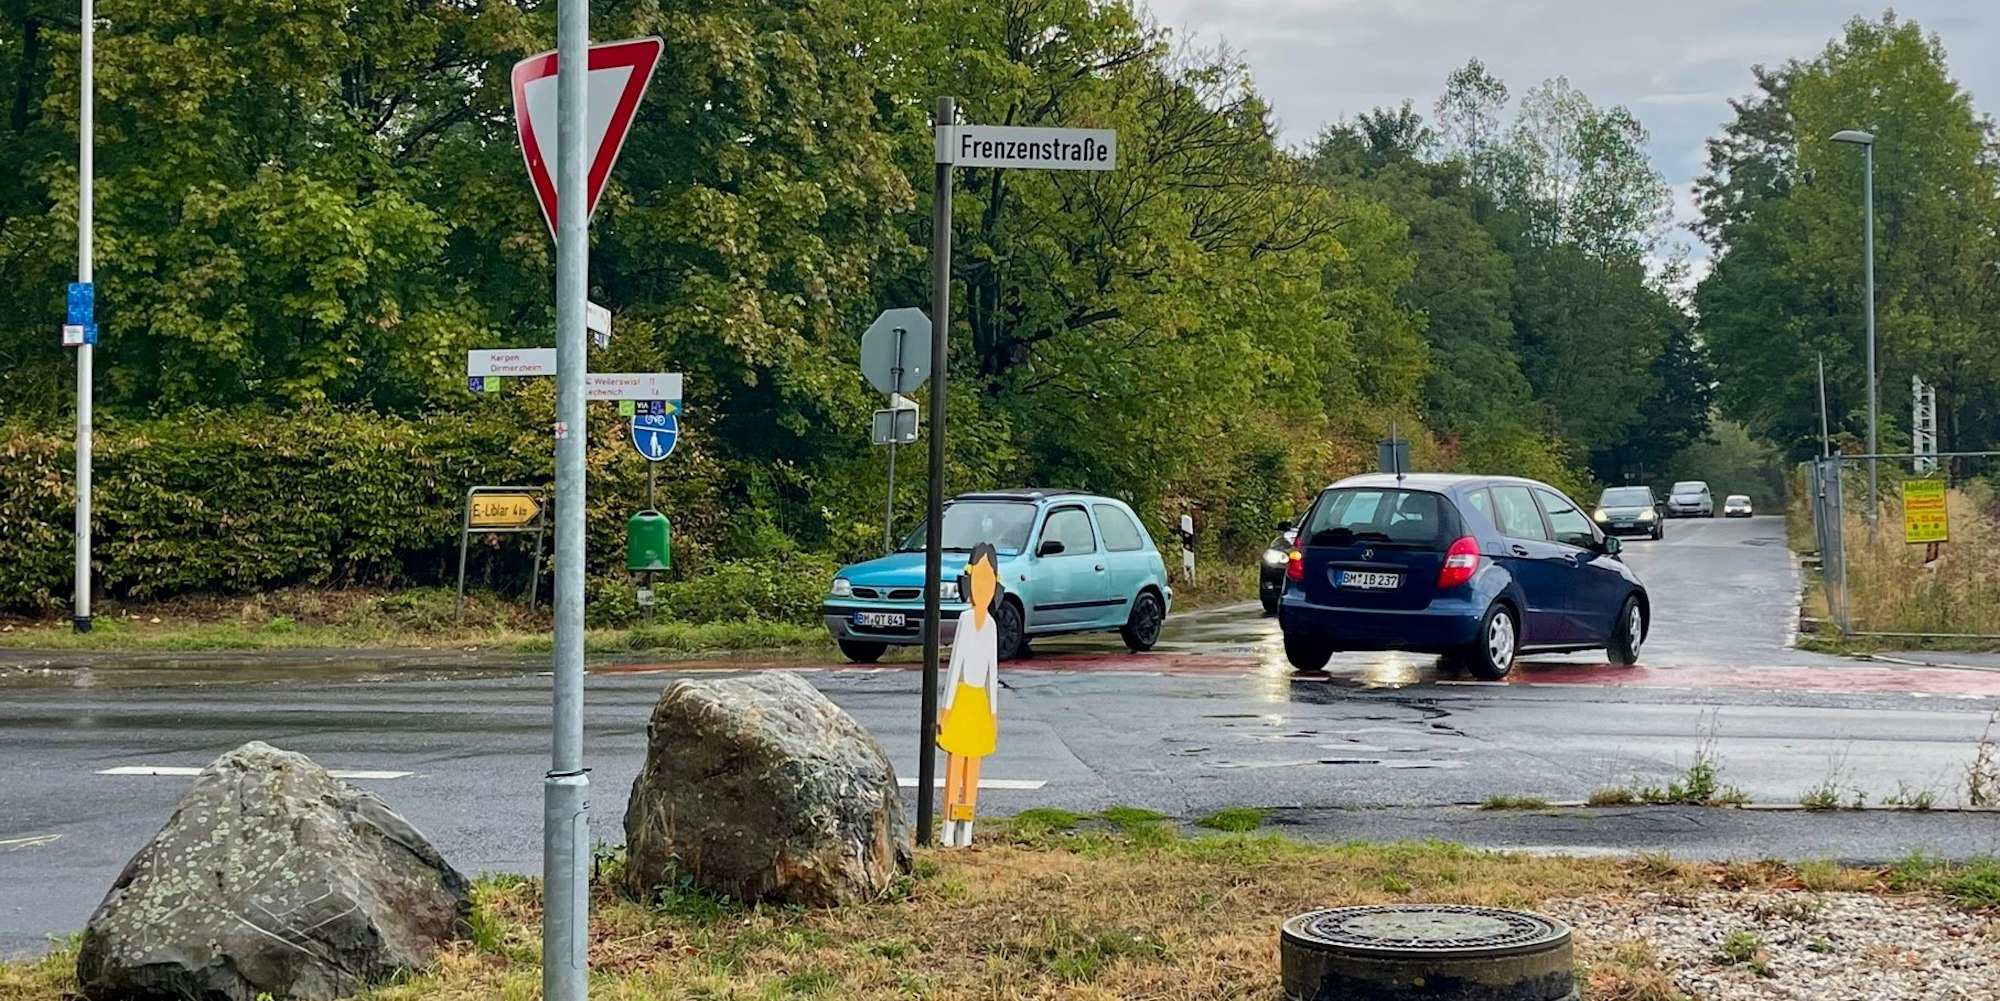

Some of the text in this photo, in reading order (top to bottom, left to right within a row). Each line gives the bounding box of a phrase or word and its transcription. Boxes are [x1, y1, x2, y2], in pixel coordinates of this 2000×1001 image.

[961, 134, 1108, 162] Frenzenstraße
[490, 354, 520, 363] Kerpen
[490, 364, 542, 373] Dirmerzheim
[587, 388, 624, 396] echenich
[636, 401, 650, 410] VIA
[1343, 573, 1398, 586] BM IB 237
[858, 613, 904, 626] BM QT 841
